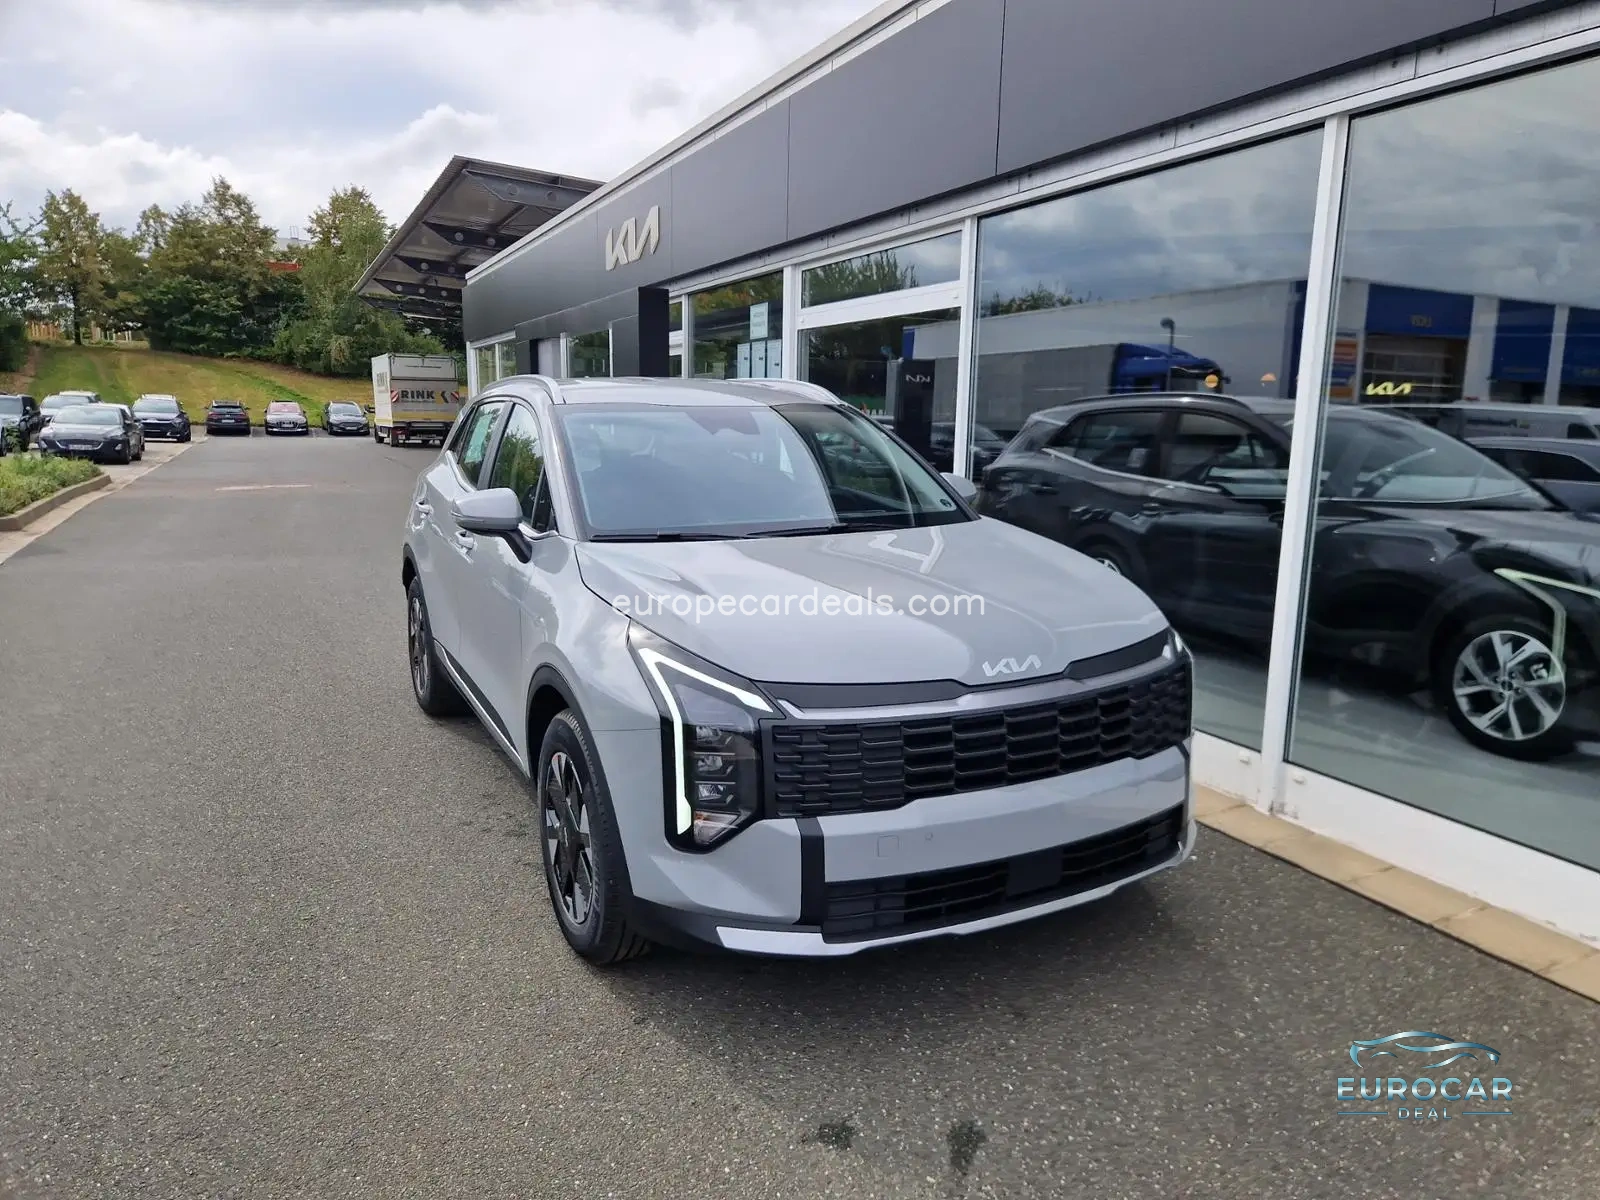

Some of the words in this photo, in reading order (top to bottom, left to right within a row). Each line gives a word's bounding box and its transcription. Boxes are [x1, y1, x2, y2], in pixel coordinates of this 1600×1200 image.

[605, 205, 660, 271] KIA
[400, 389, 435, 400] RINK
[1365, 381, 1412, 396] KIA
[982, 654, 1042, 677] KIA
